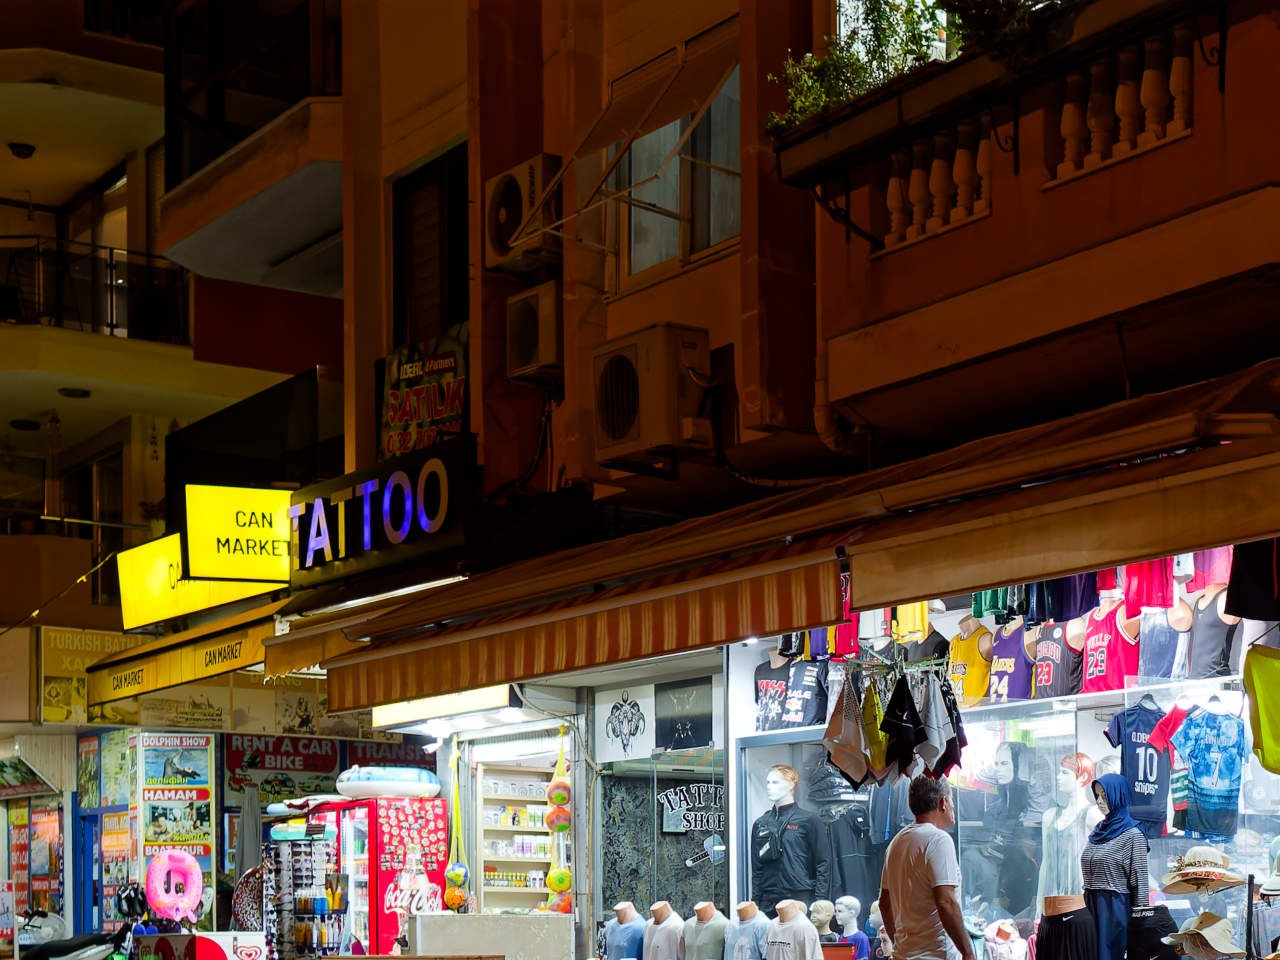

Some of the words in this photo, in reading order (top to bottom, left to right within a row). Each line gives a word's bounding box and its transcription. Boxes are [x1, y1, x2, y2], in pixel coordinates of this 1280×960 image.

[235, 510, 273, 528] CAN
[288, 458, 449, 571] TATTOO
[216, 537, 290, 557] MARKET
[48, 632, 100, 650] TURKISH
[204, 649, 217, 667] CAN
[217, 640, 243, 662] MARKET
[1087, 648, 1108, 679] 23
[112, 674, 123, 691] CAN
[123, 668, 144, 687] MARKET
[1036, 661, 1053, 686] 23
[990, 675, 1009, 703] 24
[143, 736, 180, 746] DOLPHIN
[182, 736, 207, 746] SHOW
[232, 736, 276, 750] RENT
[282, 739, 295, 752] A
[297, 740, 333, 756] CAR
[264, 755, 304, 769] BIKE
[1136, 746, 1159, 782] 10
[1210, 750, 1223, 787] 7
[144, 790, 197, 801] HAMAM
